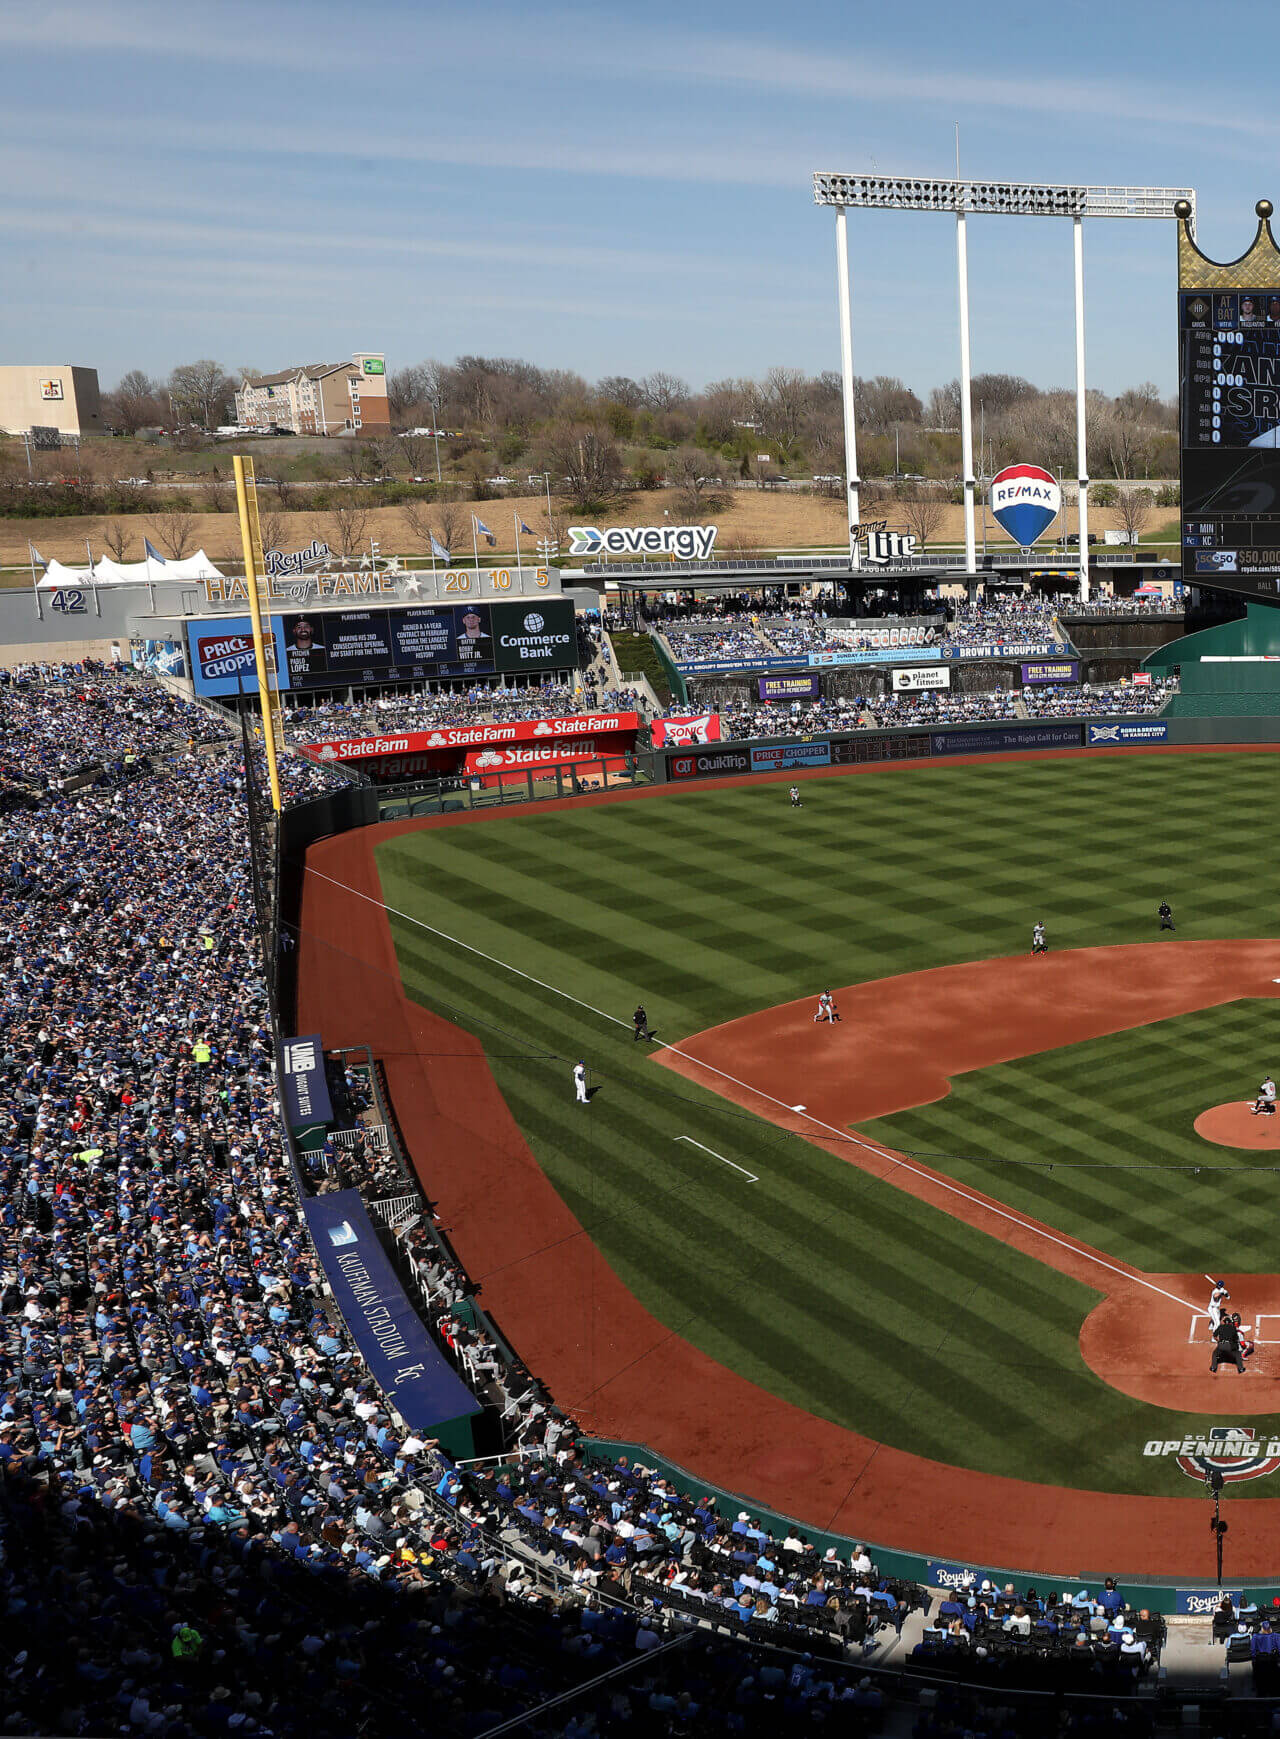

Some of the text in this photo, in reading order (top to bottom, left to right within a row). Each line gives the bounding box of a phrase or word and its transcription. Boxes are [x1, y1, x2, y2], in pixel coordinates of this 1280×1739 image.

[1194, 304, 1203, 312] HR
[1220, 296, 1232, 307] AT
[1218, 308, 1234, 320] BAT
[1213, 332, 1244, 344] .000
[1213, 344, 1222, 356] 0
[1213, 358, 1222, 370] 0
[1213, 374, 1244, 386] .000
[1212, 387, 1220, 400] 0
[1212, 401, 1220, 414] 0
[1212, 416, 1220, 428] 0
[1212, 430, 1220, 442] 0
[998, 486, 1051, 501] RE/MAX
[850, 520, 888, 542] Miller
[1200, 524, 1214, 534] MIN
[606, 528, 714, 559] evergy
[1202, 536, 1212, 546] KC
[866, 532, 916, 564] Lite
[266, 540, 331, 576] Royals
[1220, 554, 1233, 562] 50
[444, 572, 470, 592] 20
[489, 570, 512, 589] 10
[536, 568, 548, 587] 5
[204, 572, 396, 602] HAL of FAME
[1276, 578, 1280, 592] 1
[50, 588, 86, 613] 42
[500, 634, 570, 647] Commerce
[204, 638, 248, 660] PRICE
[460, 650, 482, 660] WITT JR.
[520, 647, 552, 659] Bank
[960, 644, 1048, 657] BROWN & CROUPPEN
[204, 646, 274, 678] CHOPPR
[291, 664, 310, 673] LOPEZ
[912, 672, 938, 680] planet
[782, 679, 812, 688] TRAINING
[916, 679, 944, 687] fitness
[670, 726, 704, 738] SONIC
[1018, 736, 1036, 744] Right
[1063, 732, 1079, 740] Care
[756, 746, 825, 761] PRICE CHOPPER
[675, 755, 748, 774] QT QuikTrip
[290, 1042, 316, 1072] UMB
[336, 1252, 410, 1360] KAUFFMAN STADIUM
[394, 1364, 425, 1385] KC
[1143, 1440, 1260, 1457] OPENING
[936, 1568, 978, 1588] Royals
